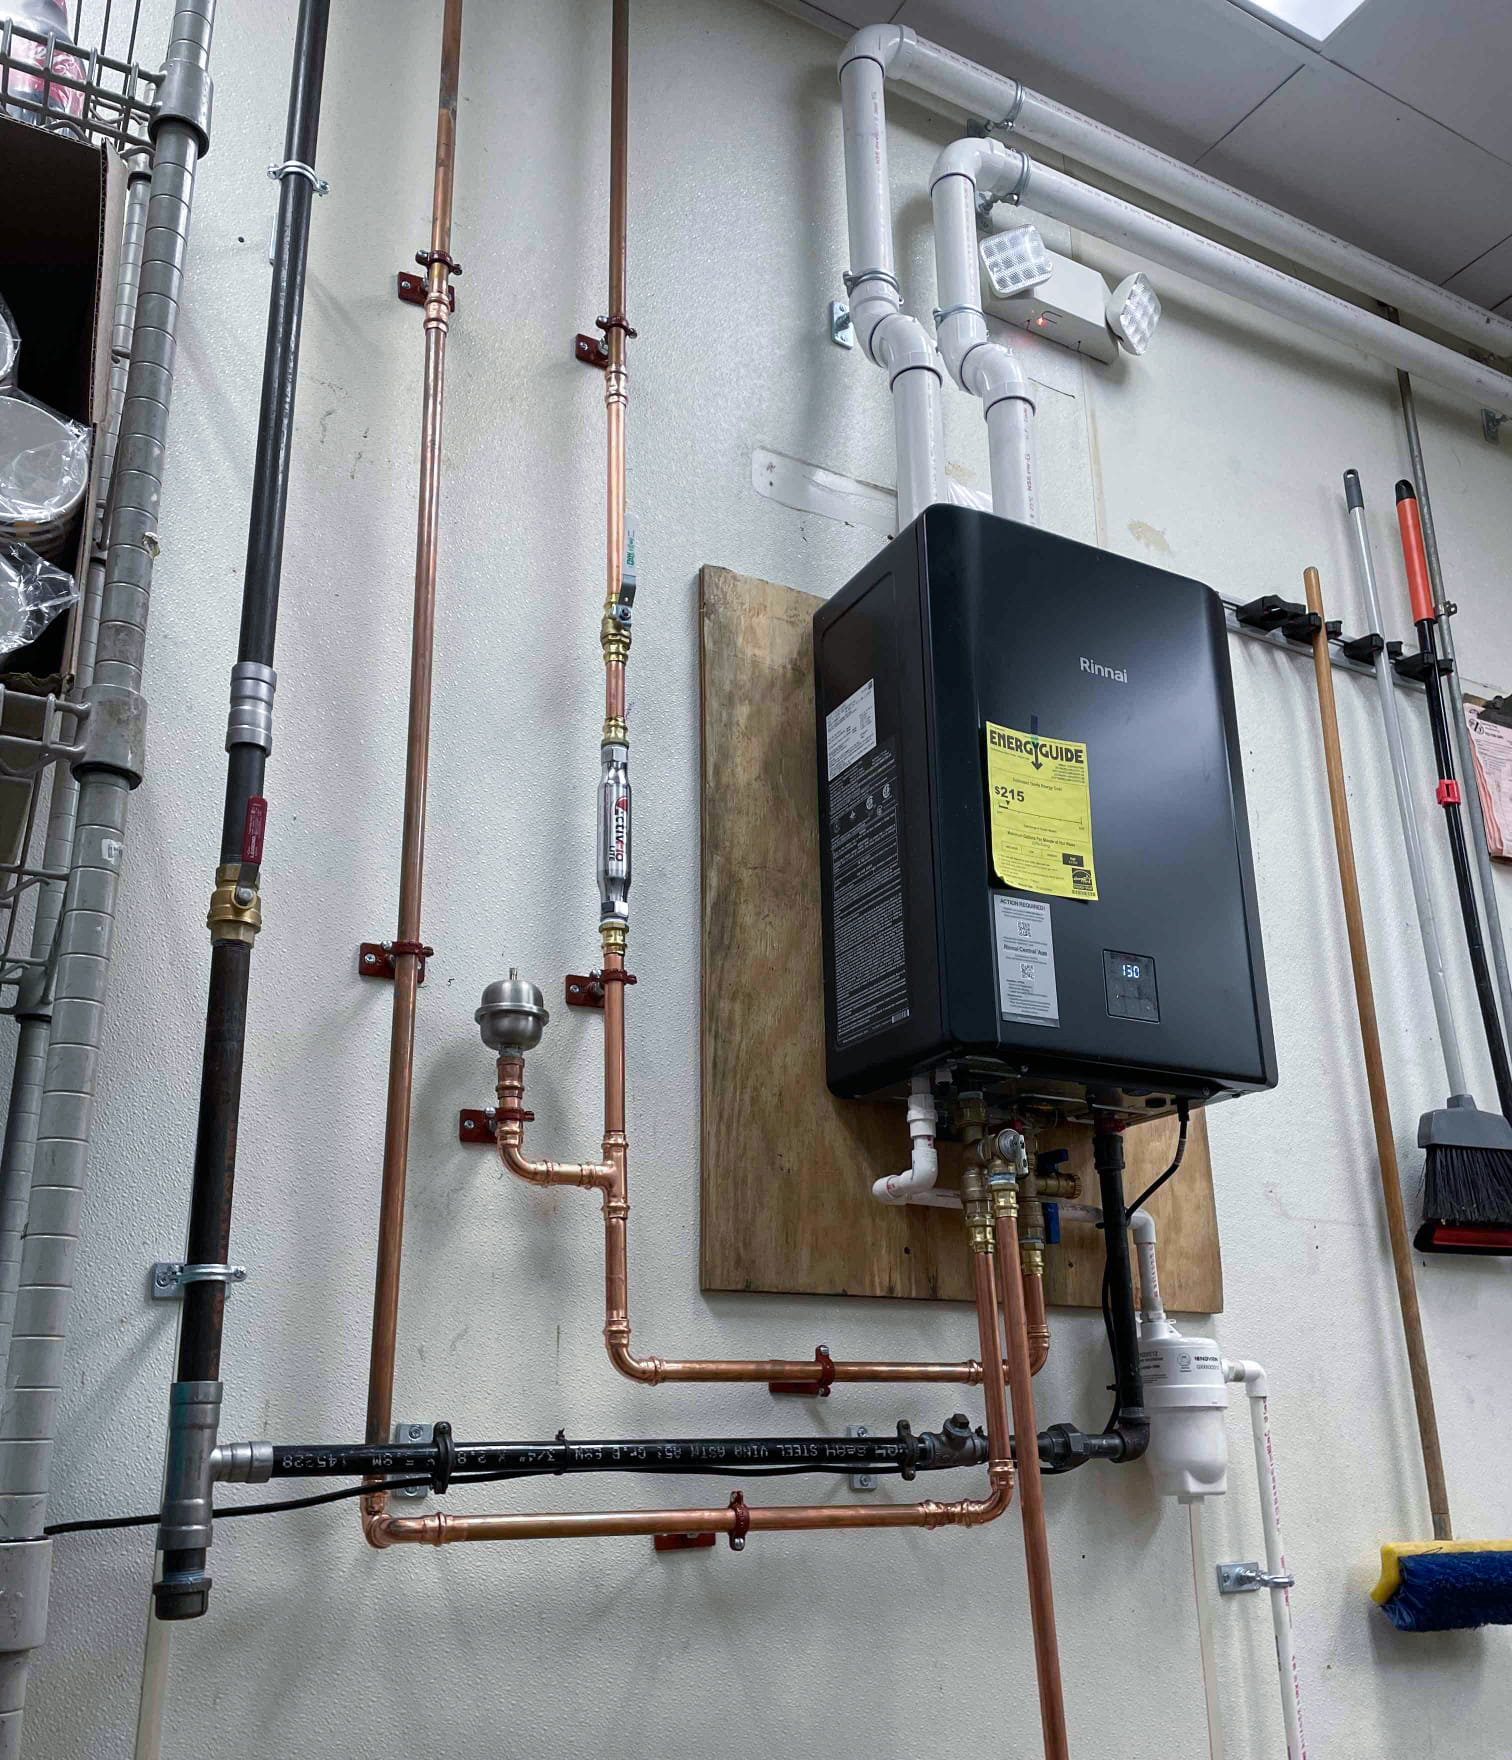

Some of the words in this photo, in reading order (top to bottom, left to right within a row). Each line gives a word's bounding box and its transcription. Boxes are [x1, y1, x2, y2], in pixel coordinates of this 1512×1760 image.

[1079, 656, 1128, 684] Rinnai
[989, 729, 1084, 765] ENERGYGUIDE
[994, 785, 1025, 802] $215
[1000, 898, 1019, 907] ACTION
[691, 1444, 726, 1459] ASTM
[734, 1444, 768, 1458] VINA
[776, 1444, 818, 1457] STEEL
